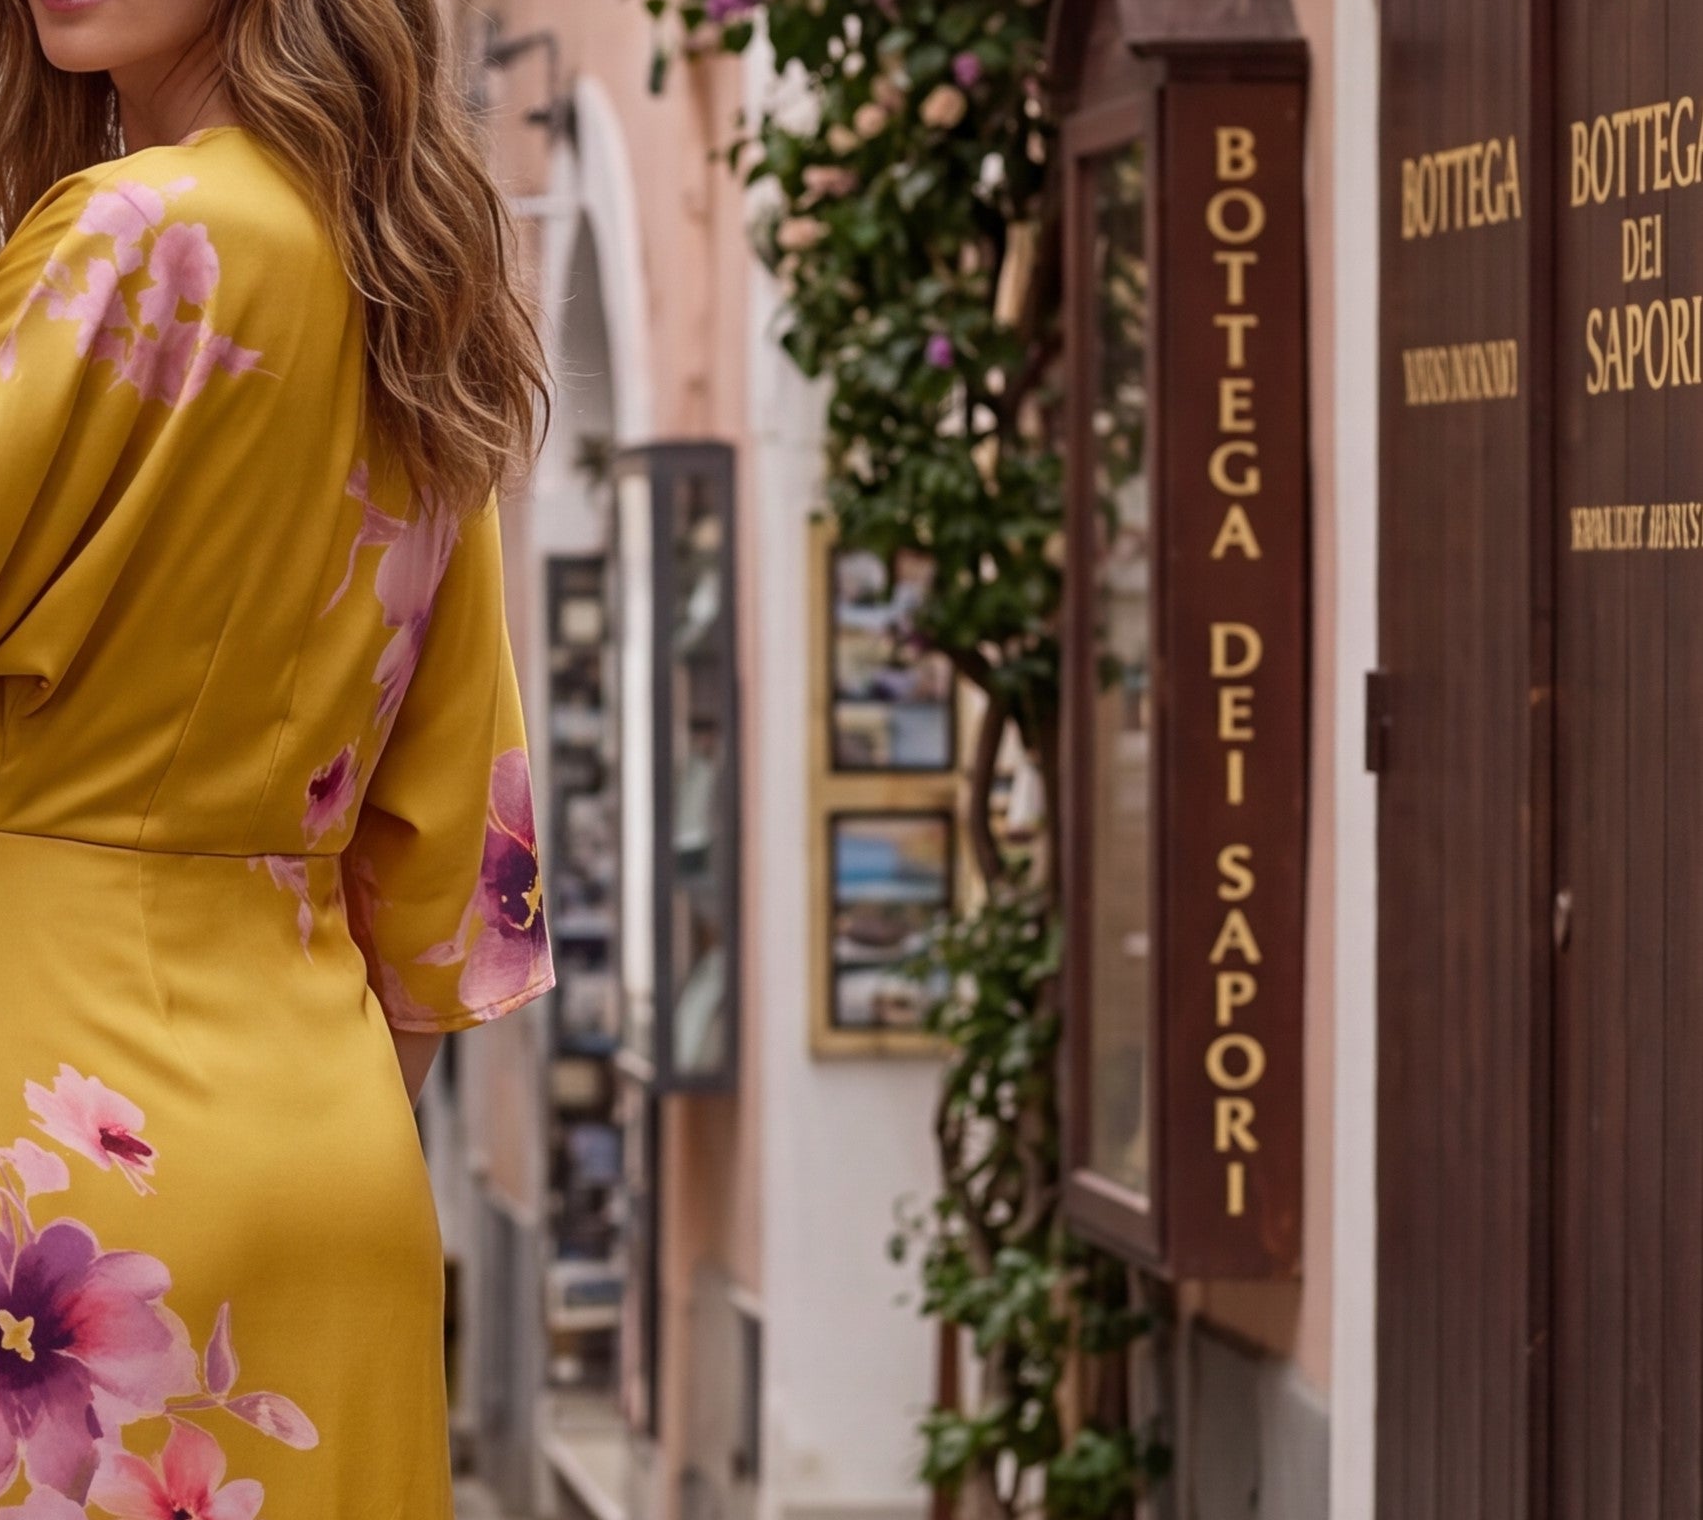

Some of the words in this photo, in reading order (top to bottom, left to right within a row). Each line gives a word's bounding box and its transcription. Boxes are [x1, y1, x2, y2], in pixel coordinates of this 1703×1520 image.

[1401, 134, 1522, 240] BOTTEGA
[1621, 213, 1662, 284] DEI
[1205, 126, 1266, 560] BOTTEGA
[1586, 295, 1703, 396] SAPORI
[1209, 622, 1264, 806] DEI
[1205, 844, 1267, 1216] SAPORI
